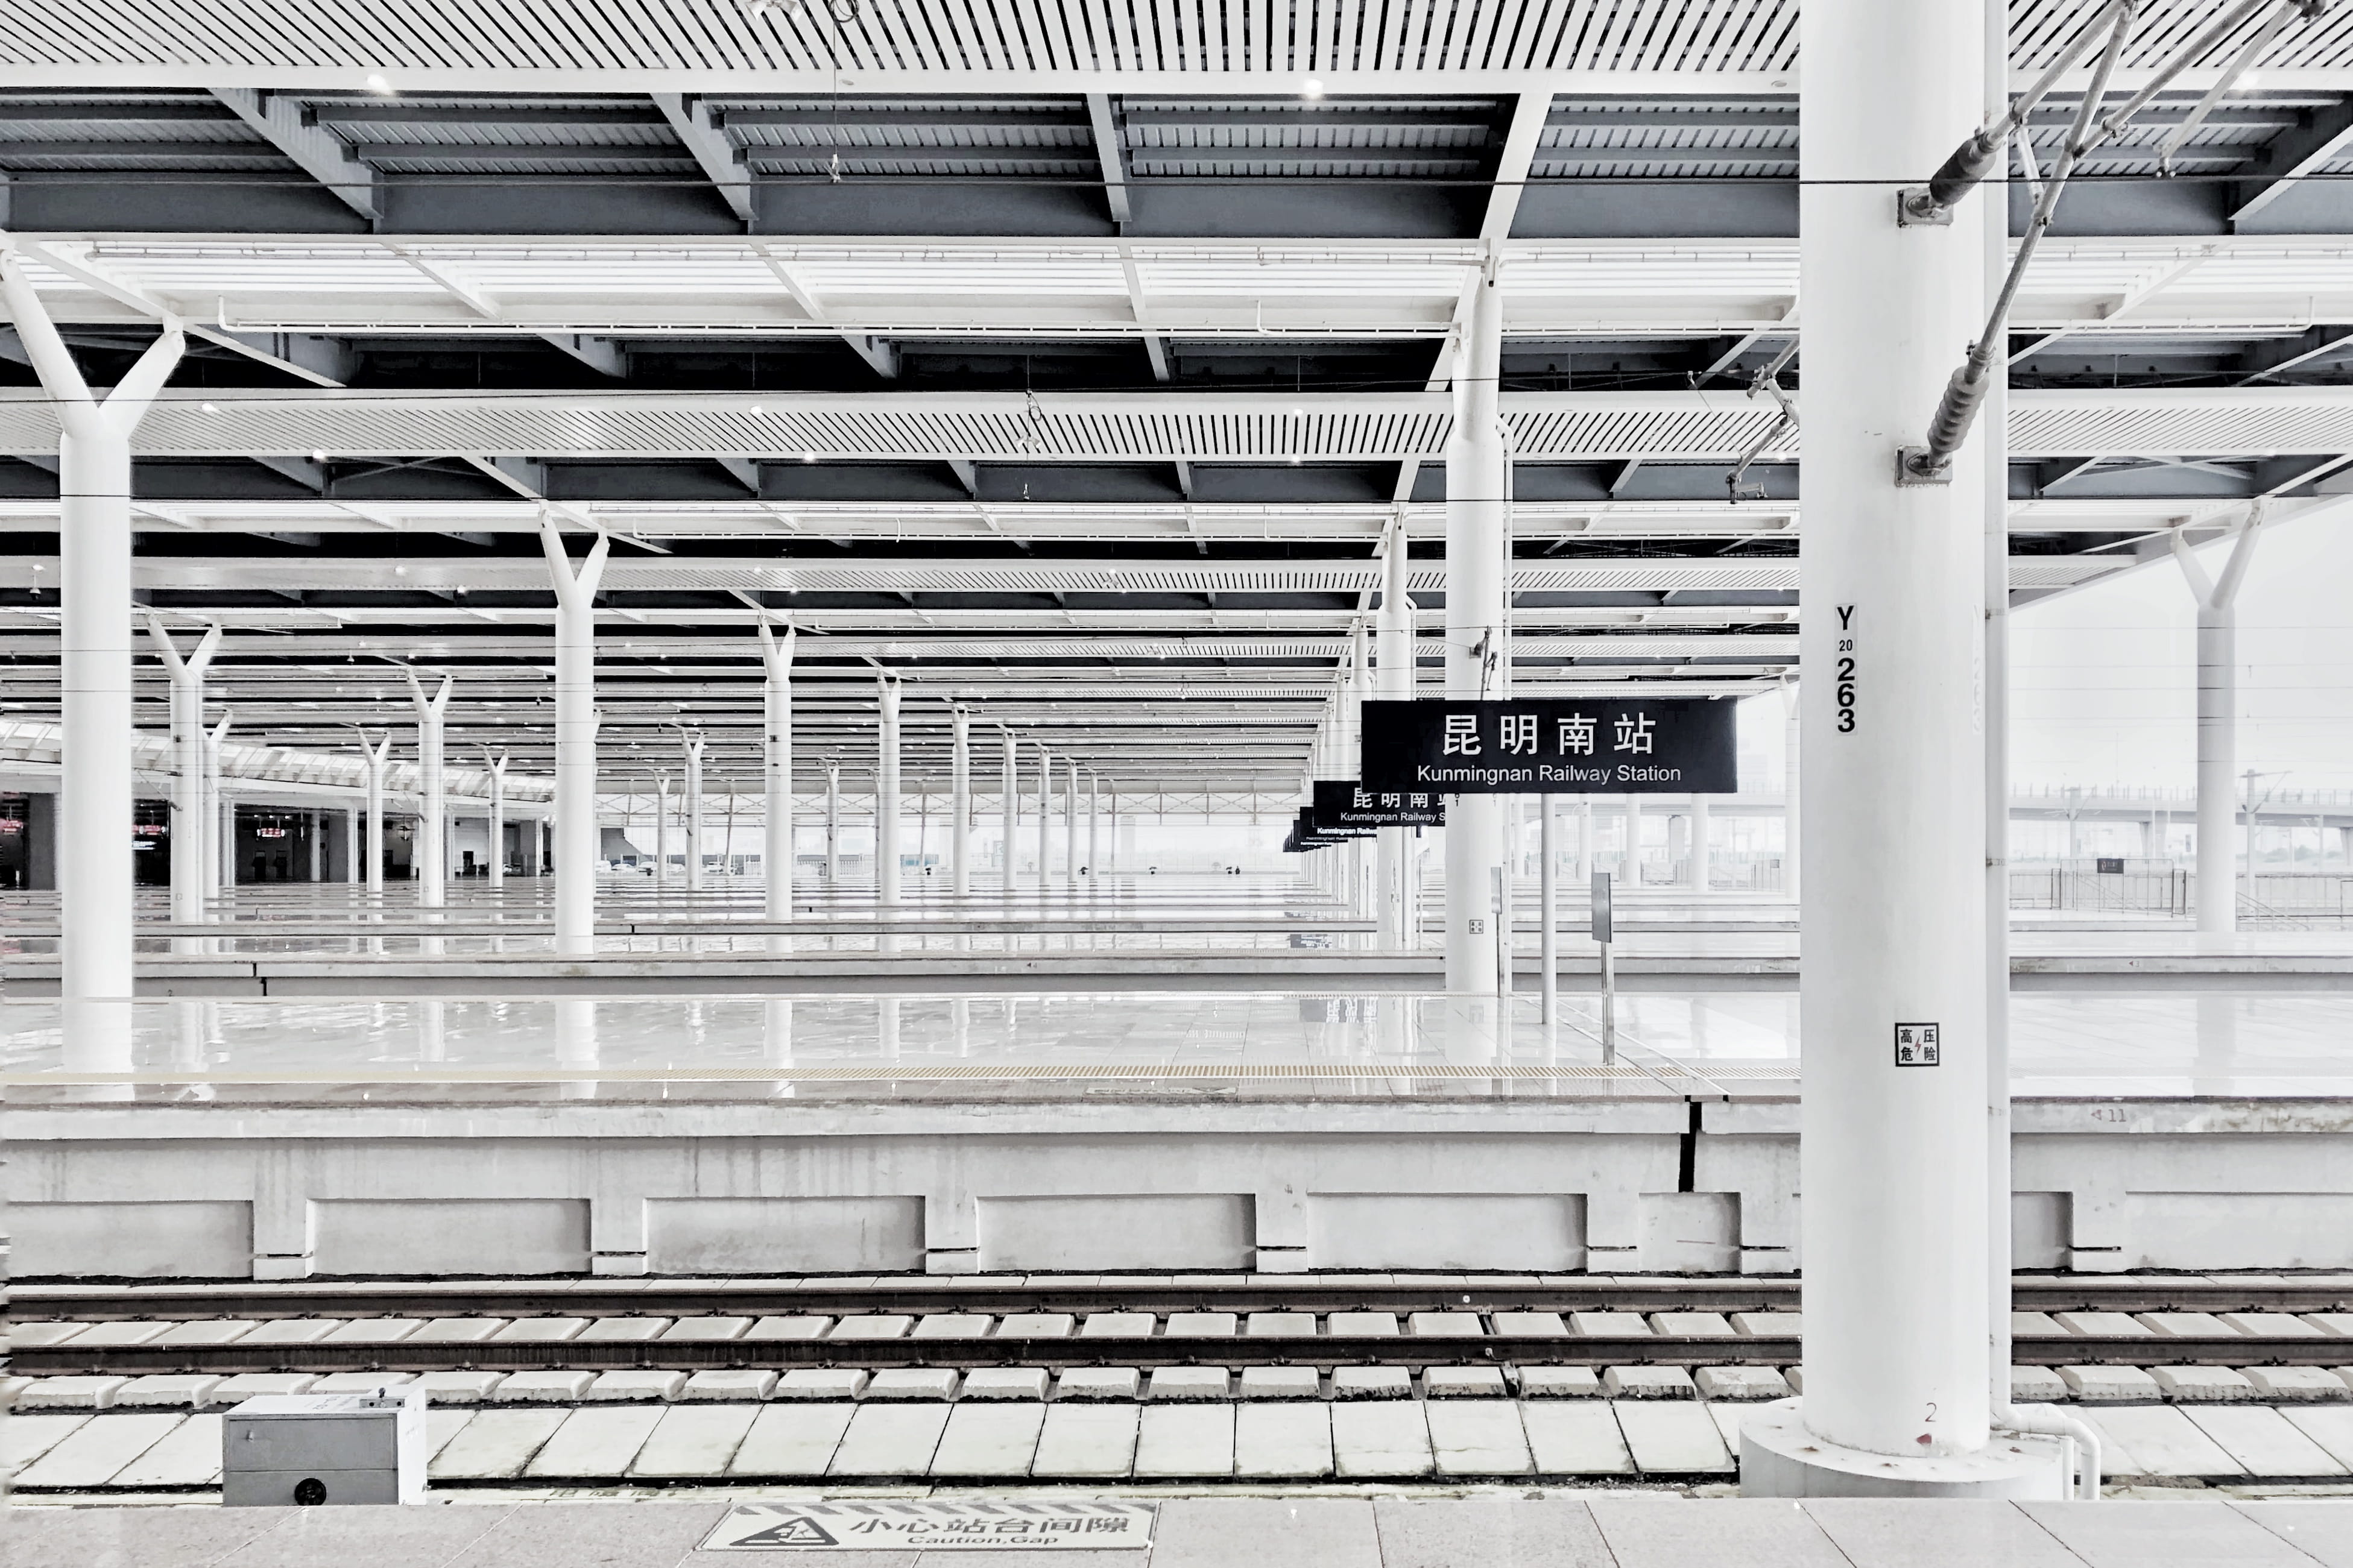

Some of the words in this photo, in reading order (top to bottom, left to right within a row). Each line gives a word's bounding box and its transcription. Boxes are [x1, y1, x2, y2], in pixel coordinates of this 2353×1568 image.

[1839, 639, 1853, 652] 20
[1443, 712, 1656, 755] 昆明南站
[1418, 764, 1532, 785] Kunmingnan
[1540, 764, 1611, 785] Railway
[1617, 764, 1681, 781] Station
[1341, 812, 1398, 823] Kunmingnan
[1400, 812, 1436, 823] Railway
[2108, 1109, 2126, 1122] 11
[1925, 1402, 1937, 1422] 2
[849, 1518, 1130, 1533] 小心站台间隙
